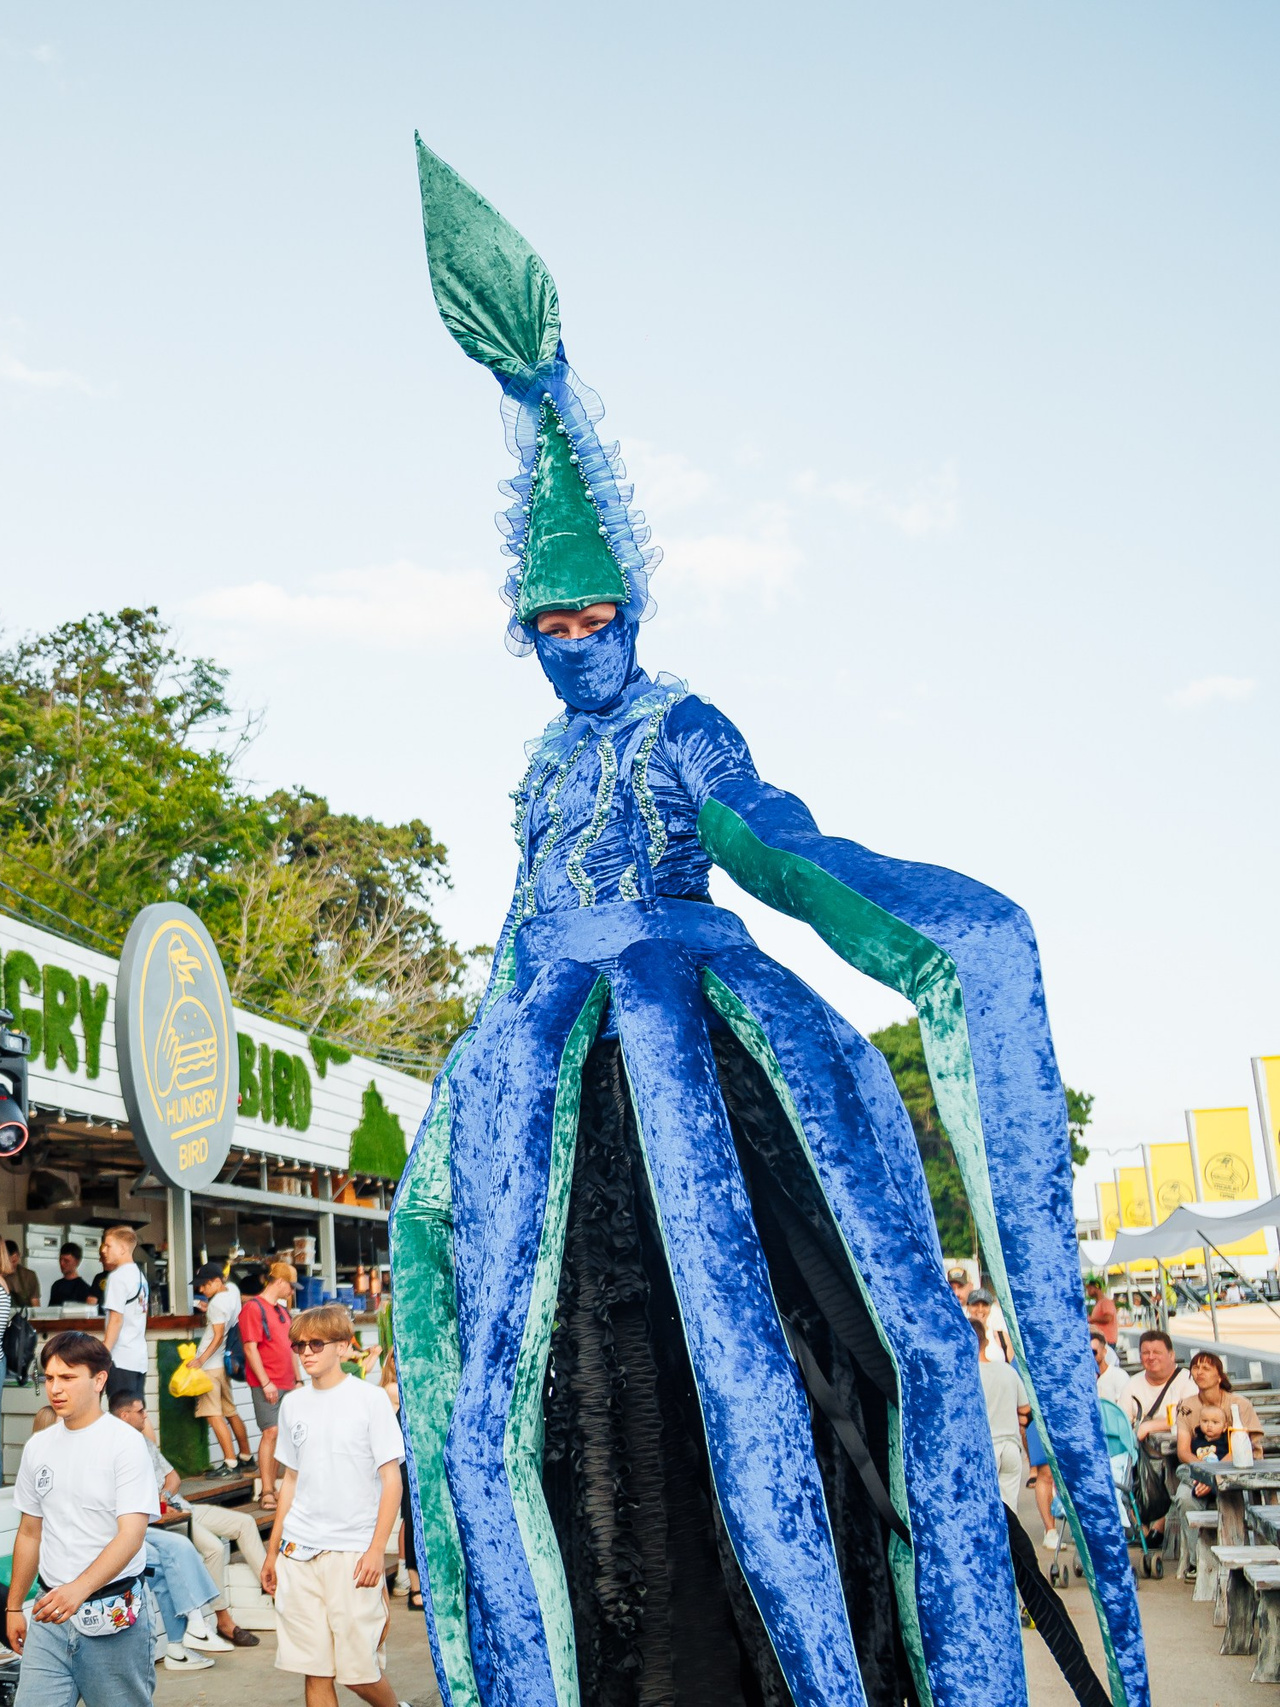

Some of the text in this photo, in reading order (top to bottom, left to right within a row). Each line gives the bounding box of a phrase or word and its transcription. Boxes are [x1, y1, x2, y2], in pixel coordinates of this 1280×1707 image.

[238, 1032, 312, 1132] BIRD
[166, 1086, 218, 1127] HUNGRY
[179, 1137, 209, 1171] BIRD
